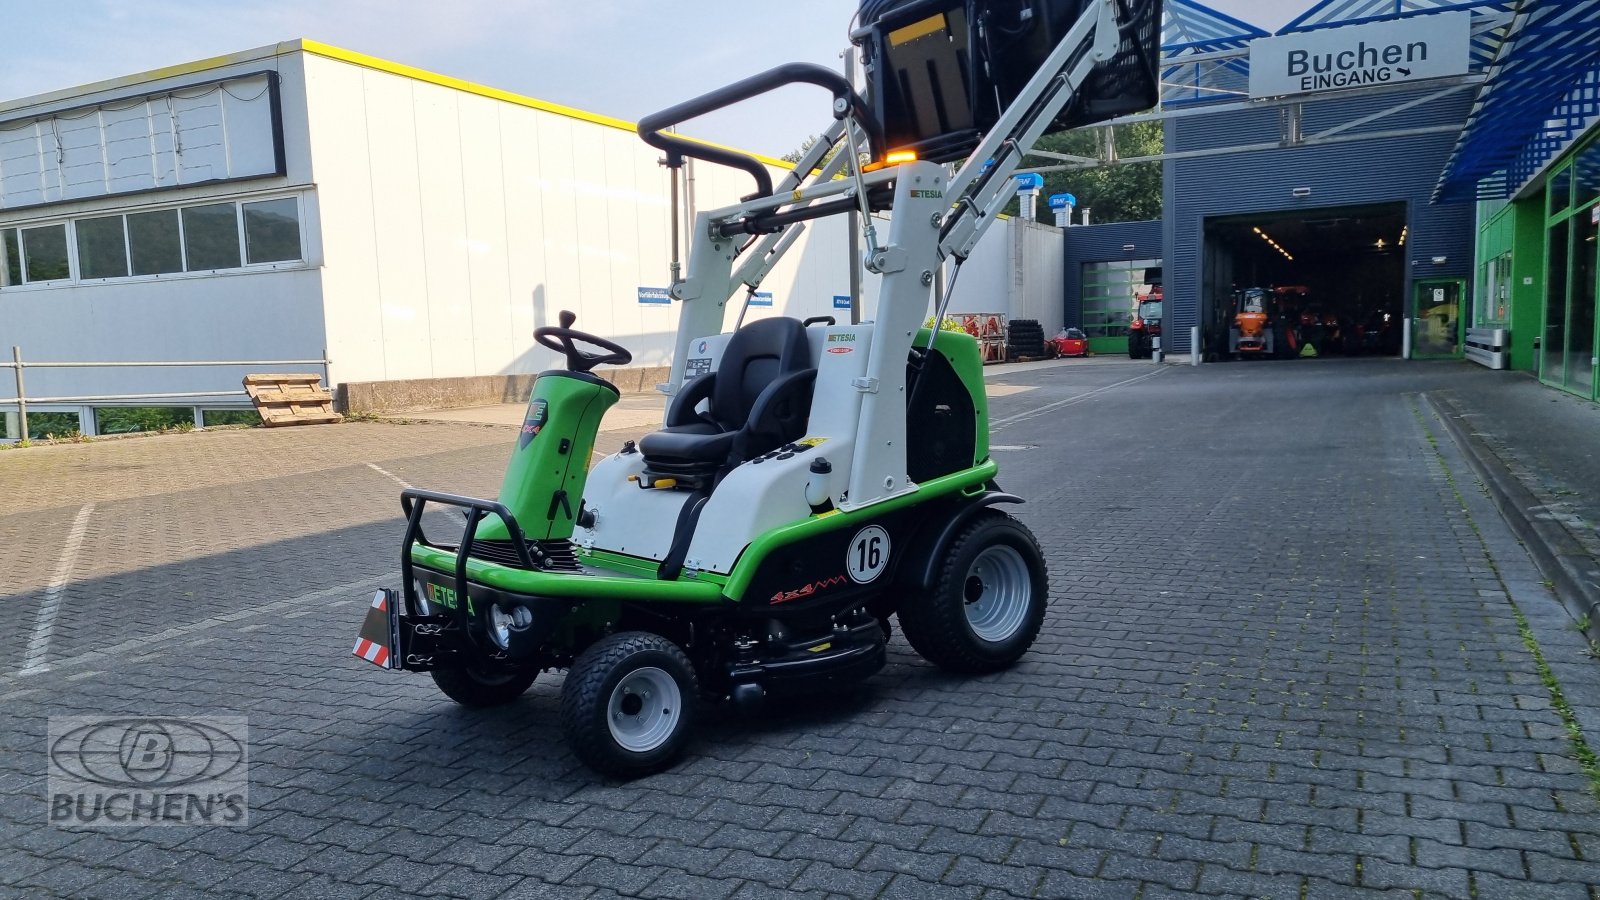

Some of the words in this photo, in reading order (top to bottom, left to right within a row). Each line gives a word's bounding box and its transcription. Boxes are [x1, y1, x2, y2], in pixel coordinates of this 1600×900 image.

[1287, 41, 1428, 77] Buchen
[1300, 66, 1392, 91] EINGANG
[910, 189, 943, 199] ETESIA
[828, 333, 856, 342] ETESIA
[857, 536, 881, 572] 16
[427, 582, 476, 617] ETEA
